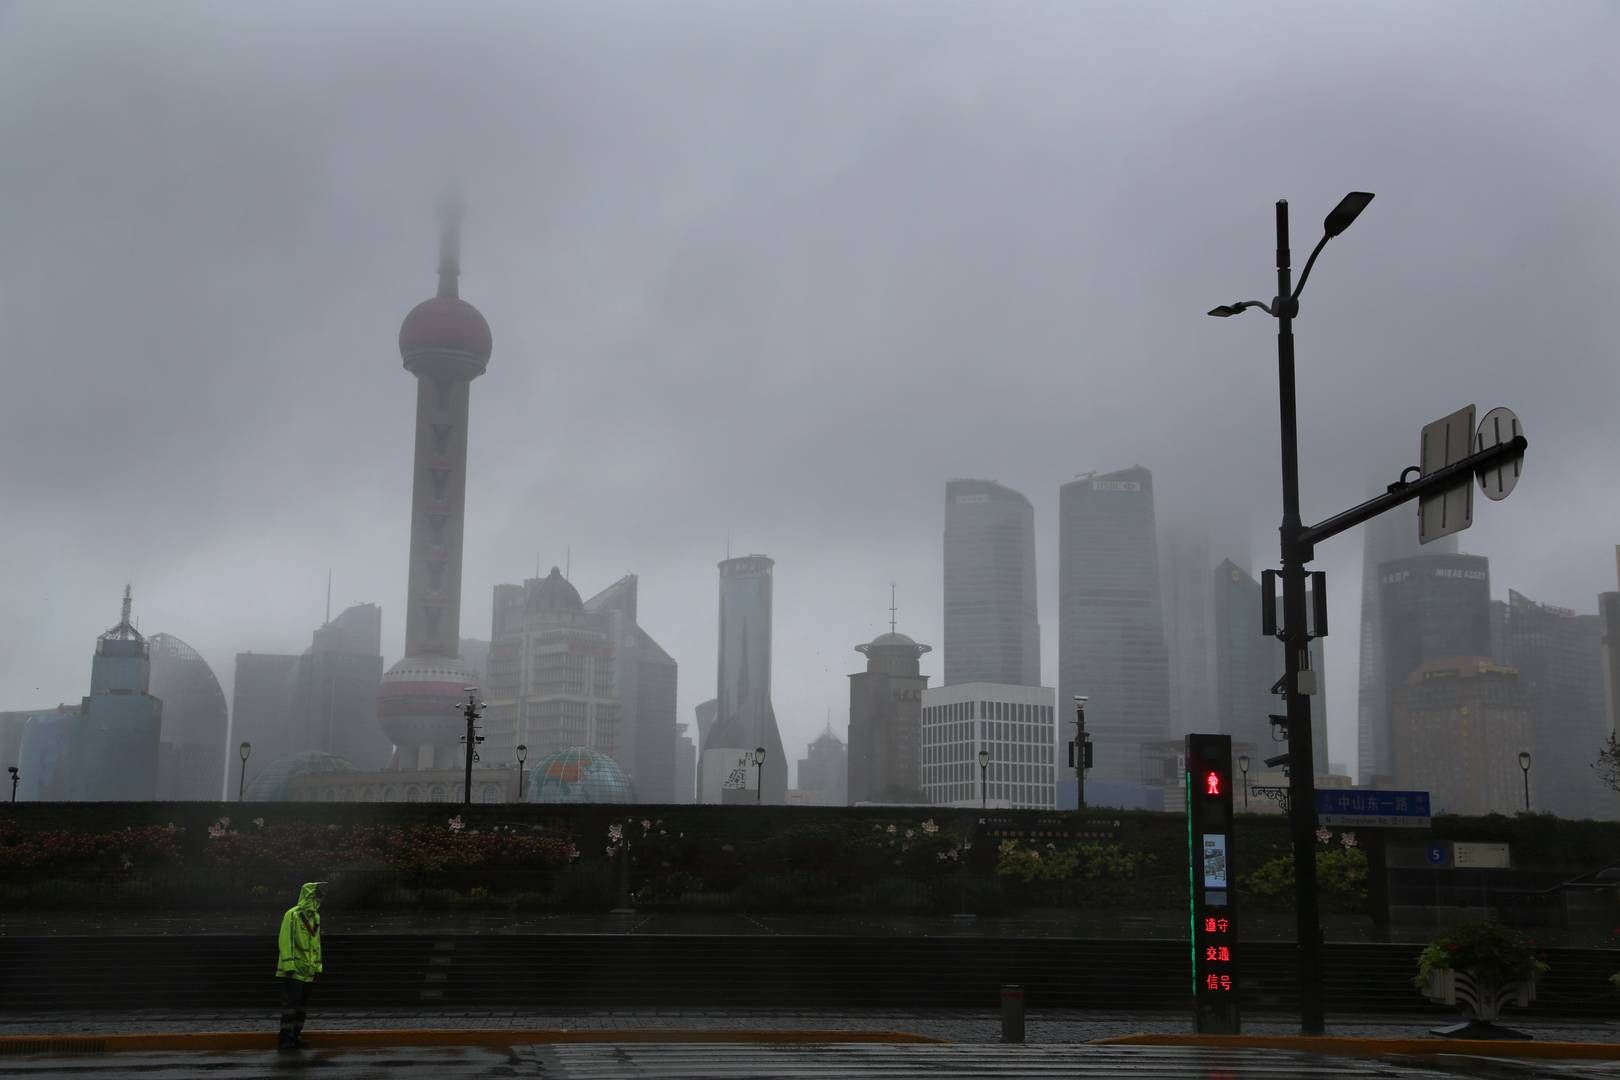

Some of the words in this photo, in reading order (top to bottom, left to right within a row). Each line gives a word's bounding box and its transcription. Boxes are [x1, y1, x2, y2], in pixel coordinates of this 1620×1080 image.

[1337, 793, 1408, 812] 中山东一路
[1432, 848, 1440, 860] 5
[1206, 946, 1229, 961] 交通
[1207, 974, 1232, 990] 信号
